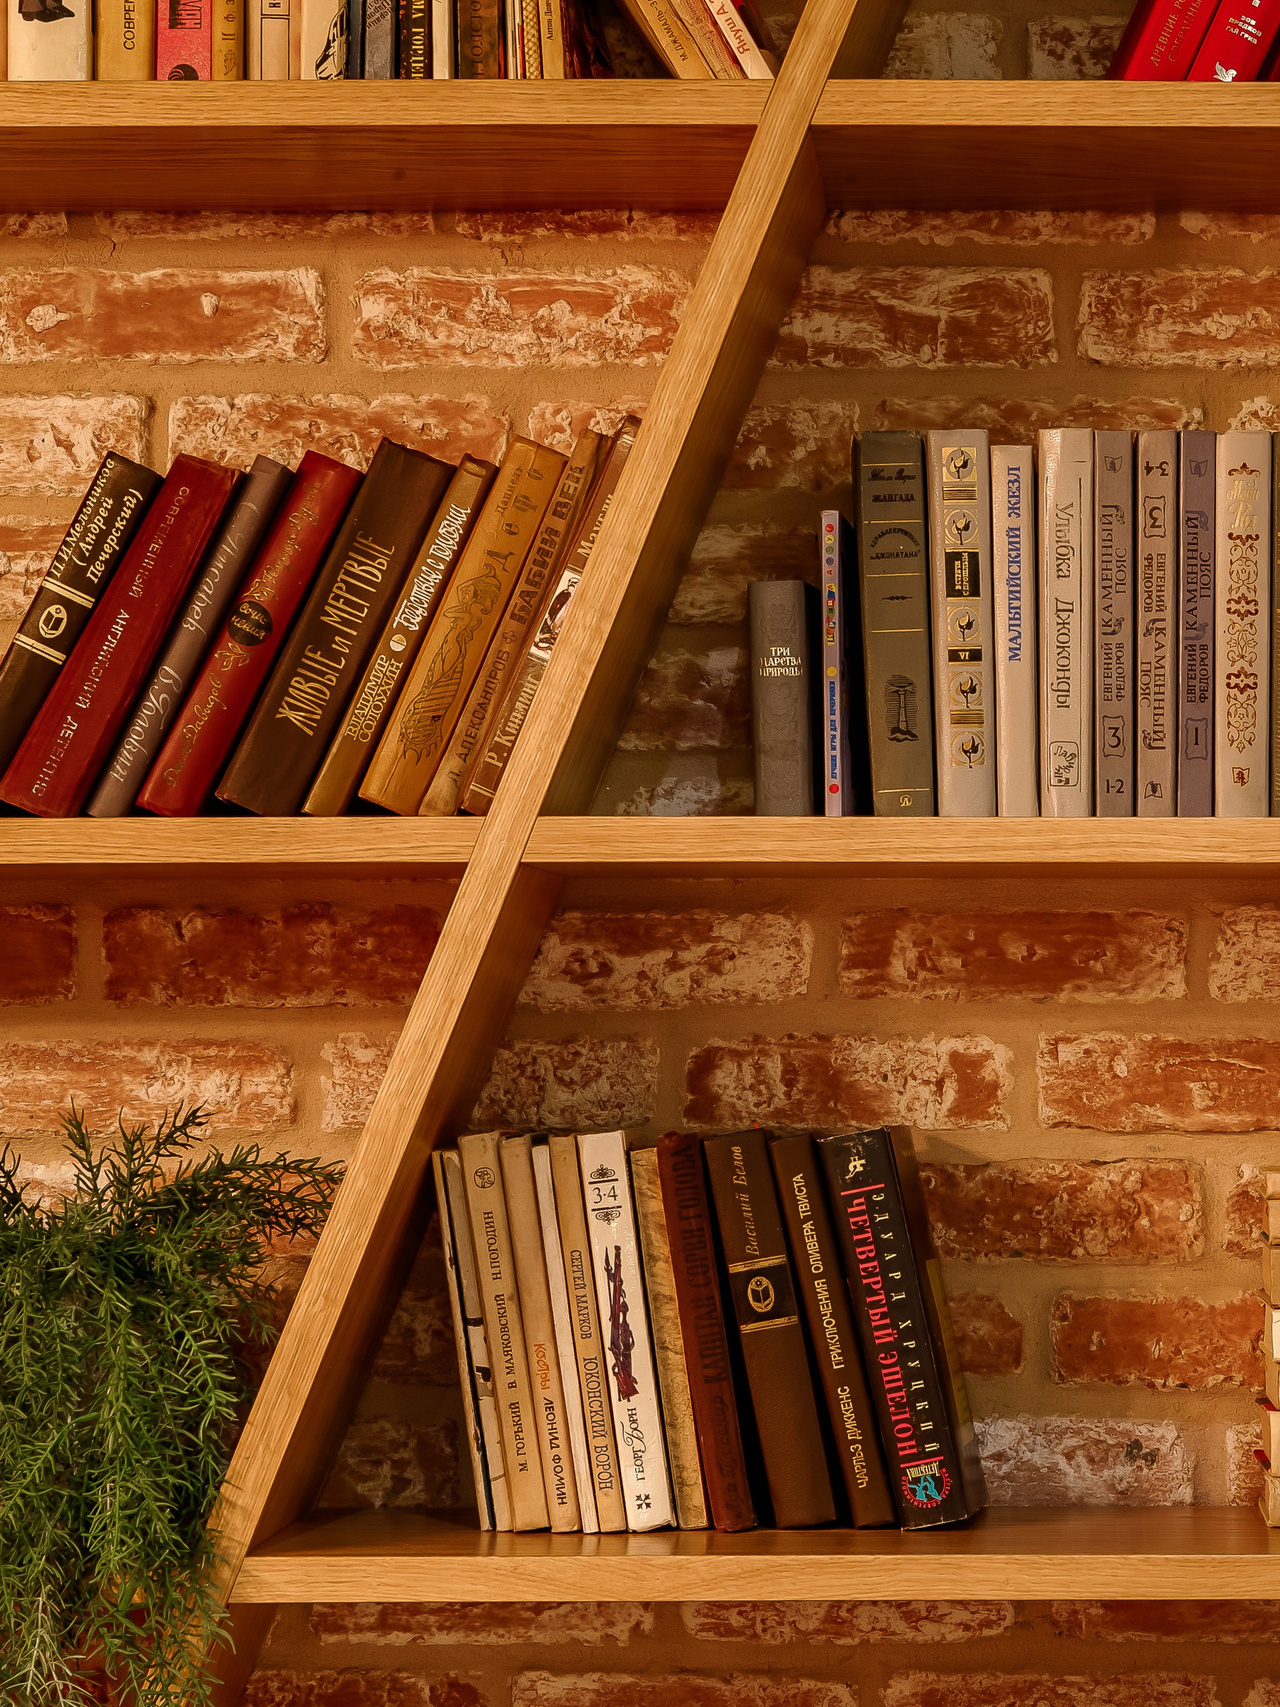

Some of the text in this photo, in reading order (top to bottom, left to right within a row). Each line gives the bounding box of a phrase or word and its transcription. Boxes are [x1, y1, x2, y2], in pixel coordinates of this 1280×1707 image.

[872, 492, 916, 503] ЖАНГАДА
[83, 486, 145, 587] Печерский)
[126, 482, 192, 599] СОВРЕМЕННЫЙ
[1005, 464, 1021, 662] МАЛЬТИЙСКИЙ ЖЕЗЛ
[1099, 512, 1114, 628] КАМЕННЫЙ
[1114, 546, 1127, 594] ПОЯС
[1050, 502, 1076, 709] Улыбка Джоконды
[1142, 551, 1154, 613] ФЕДОРОВ
[1154, 551, 1168, 612] ЕВГЕНИЙ
[1182, 515, 1200, 630] КАМЕННЫЙ
[1198, 550, 1212, 598] ПОЯС
[273, 640, 348, 735] ЖИВЫЕ
[317, 528, 399, 636] МЕРТВЫЕ
[452, 458, 590, 764] АЛЕКСАНДРОВ БАБИЙ ВЕК
[73, 607, 134, 710] АНГЛИЙСКИЙ
[770, 646, 790, 656] ТРИ
[1100, 642, 1113, 701] ЕВГЕНИЙ
[1114, 641, 1126, 701] ФЕДОРОВ
[1138, 659, 1152, 707] ПОЯС
[1152, 624, 1168, 743] КАМЕННЫЙ
[1184, 643, 1198, 703] ЕВГЕНИЙ
[1197, 642, 1210, 703] ФЕДОРОВ
[178, 671, 238, 750] Давыдов
[343, 652, 393, 740] ВЛАДИМИР
[354, 656, 404, 744] СОЛОУХИН
[482, 746, 507, 769] Р.
[727, 1144, 760, 1257] Василий Белов
[494, 1291, 516, 1375] МАЯКОВСКИЙ
[791, 1172, 871, 1488] ЧАРЛЬЗ ДИККЕНС ПРИКЛЮЧЕНИЯ ОЛИВЕРА ТВИСТА
[840, 1196, 921, 1458] ЧЕТВЕРТЫЙ ЭШЕЛОН
[506, 1378, 518, 1389] В.
[568, 1249, 616, 1491] СЕРГЕЙ МАРКОВ ЮКОНСКИЙ ВОРОН
[507, 1400, 526, 1456] ГОРЬКИЙ
[541, 1396, 560, 1450] ЛЕОНИД
[517, 1458, 529, 1472] М.
[550, 1453, 568, 1506] ФОМИН
[630, 1444, 648, 1481] ГЕОРГ
